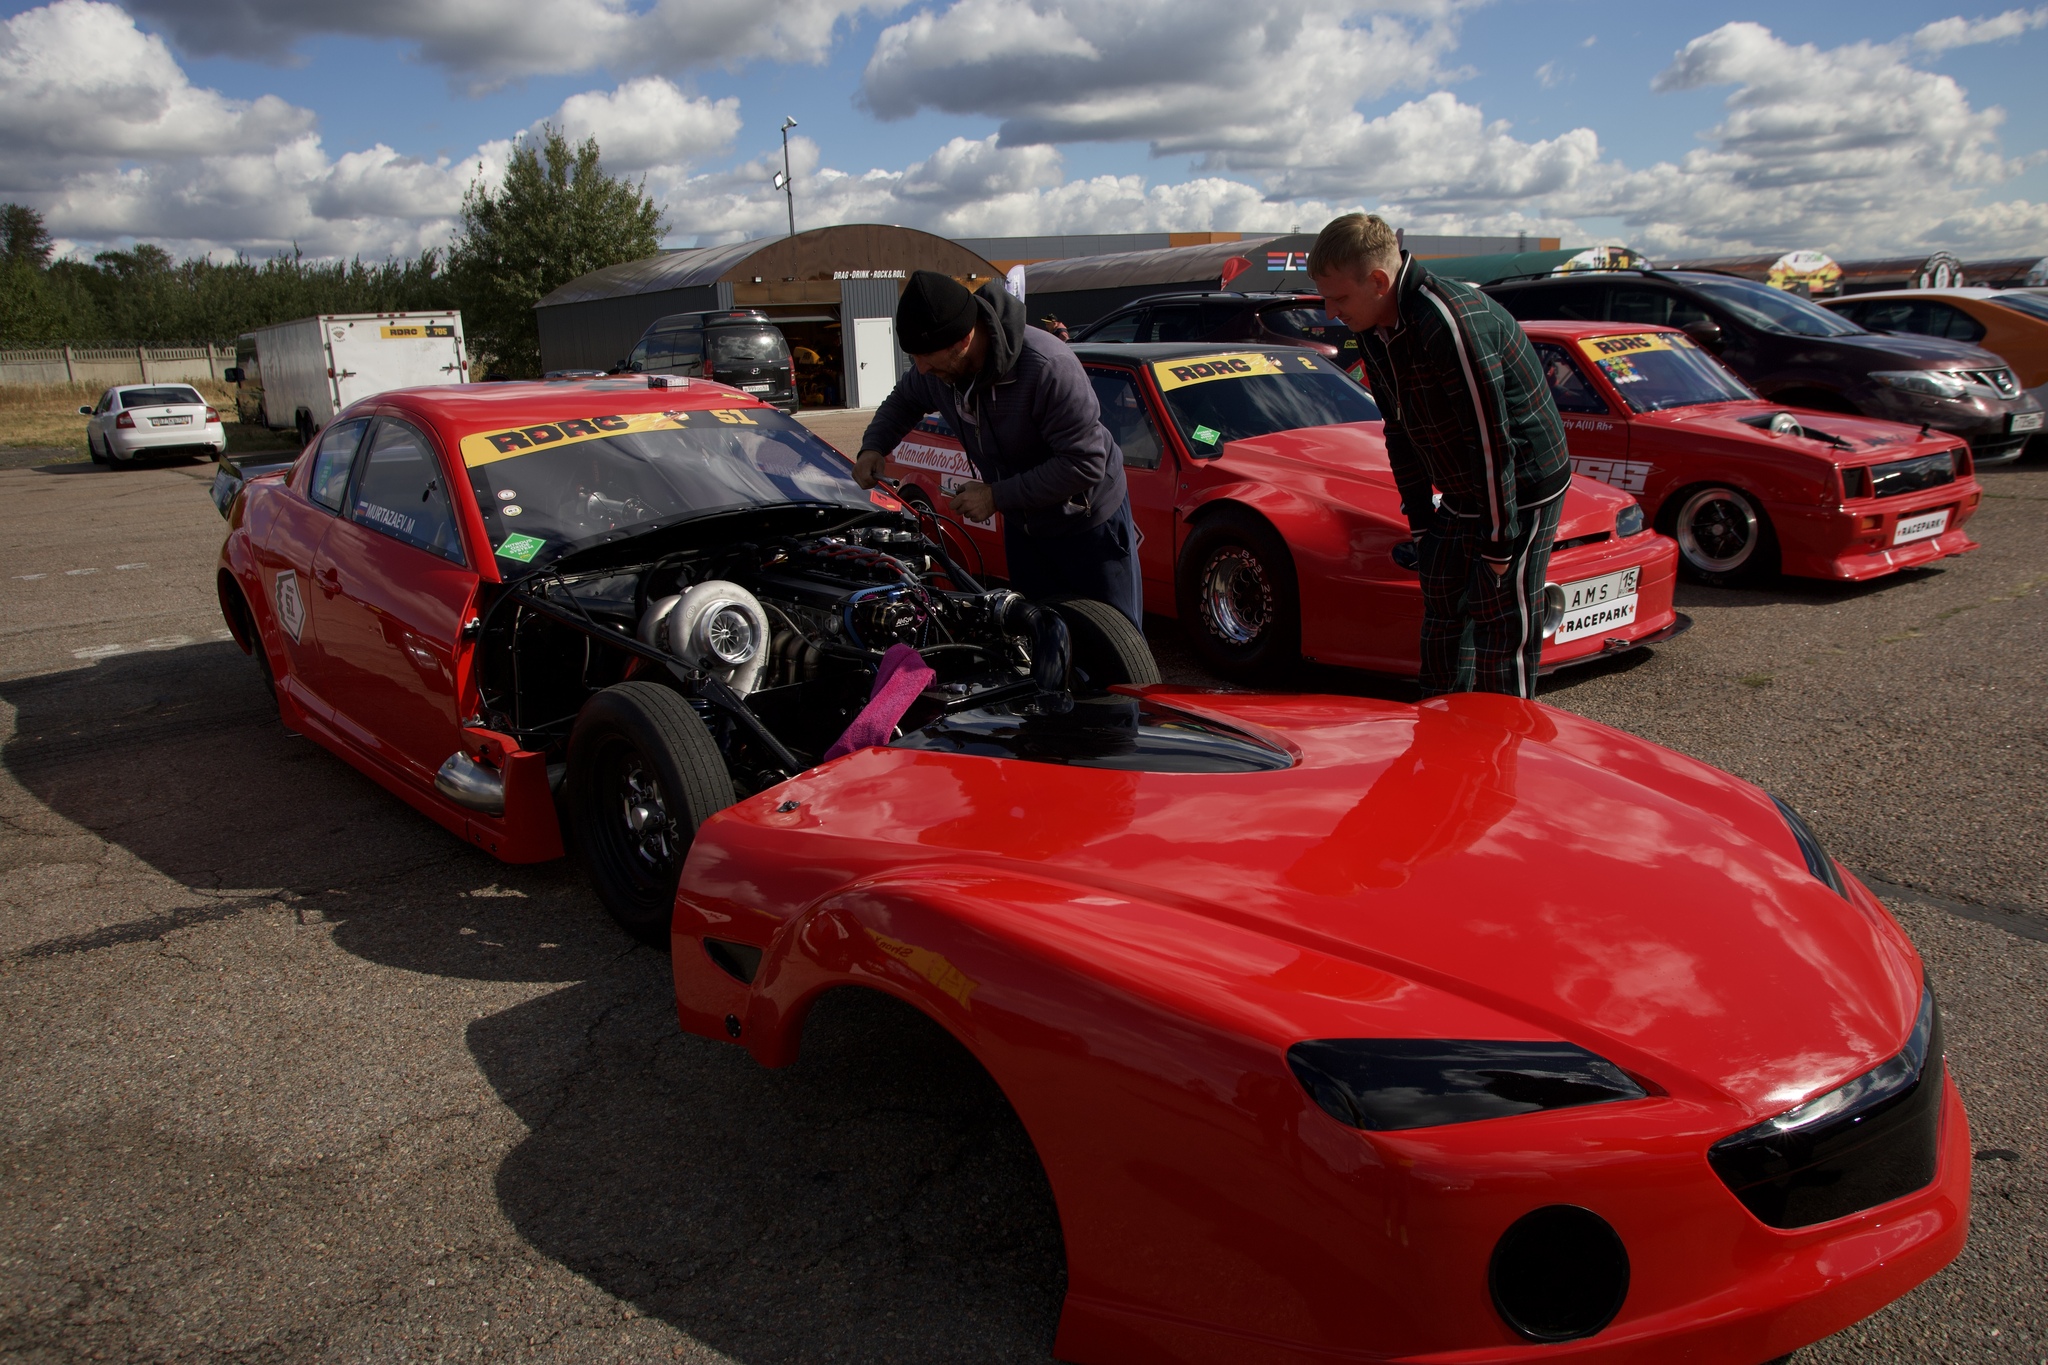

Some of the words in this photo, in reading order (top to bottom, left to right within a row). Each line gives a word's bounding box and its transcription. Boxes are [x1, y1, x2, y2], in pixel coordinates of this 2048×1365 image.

[833, 271, 849, 280] DRAG
[389, 328, 417, 336] RDRC
[433, 327, 447, 336] 705
[1593, 337, 1651, 354] RDRC
[1168, 358, 1251, 382] RDRC
[1297, 356, 1318, 370] 2
[485, 415, 630, 454] RDRC
[708, 409, 759, 425] 51
[1902, 518, 1942, 536] RACEPARK
[1572, 584, 1608, 608] AMS
[1623, 571, 1635, 588] 15
[1566, 605, 1628, 633] RACEPARK
